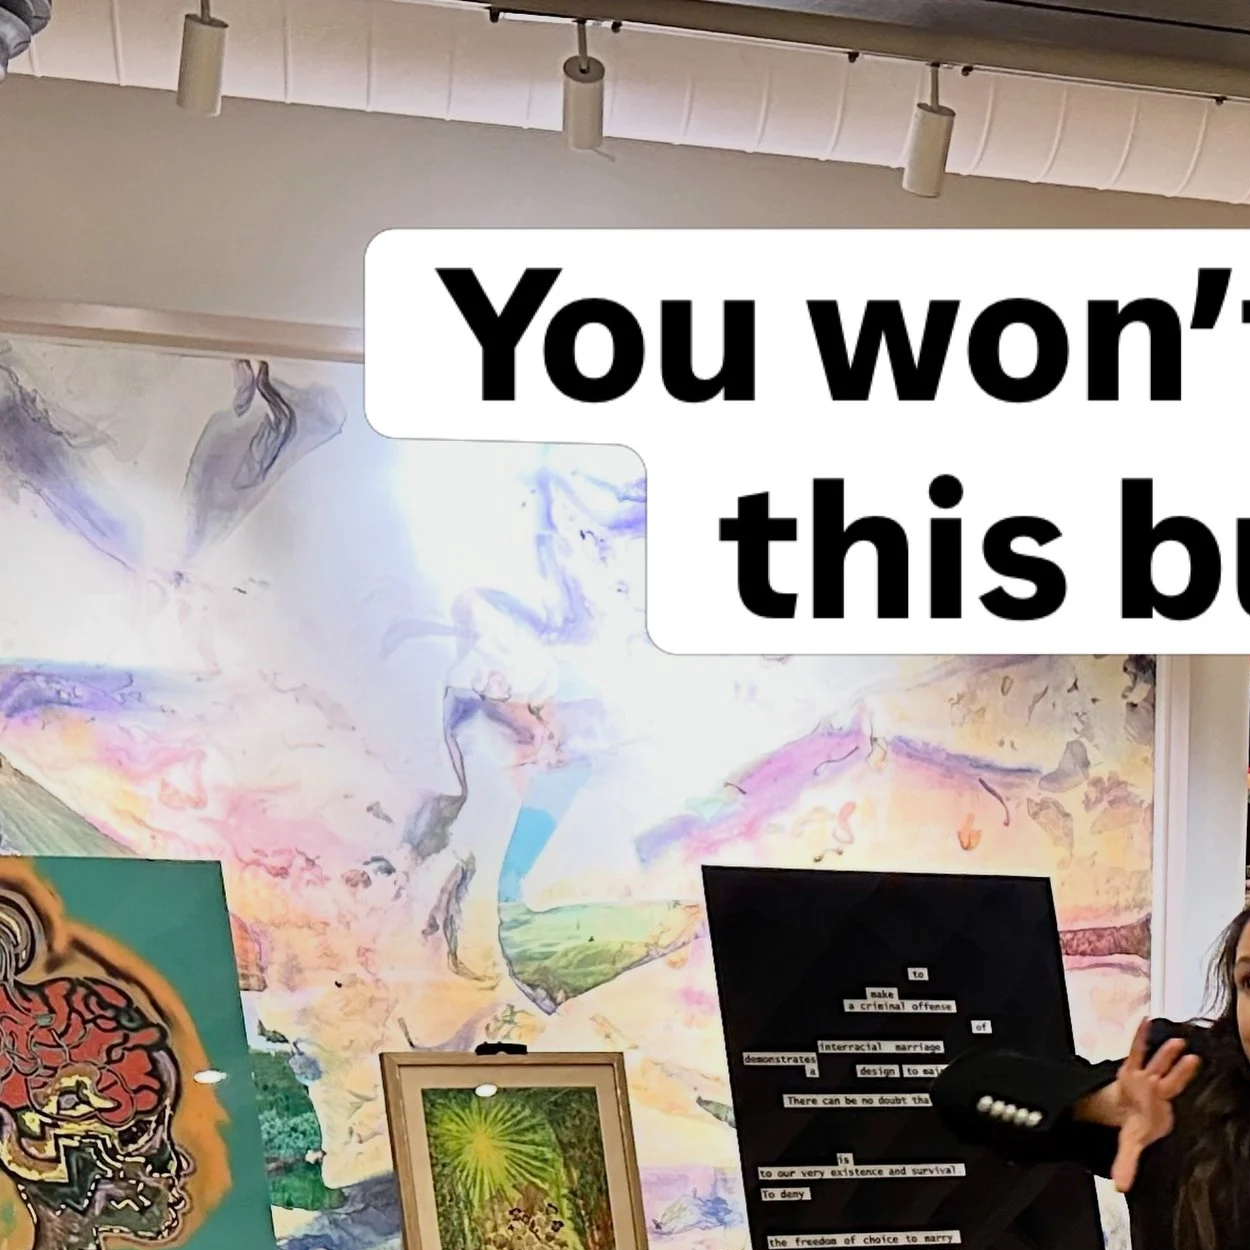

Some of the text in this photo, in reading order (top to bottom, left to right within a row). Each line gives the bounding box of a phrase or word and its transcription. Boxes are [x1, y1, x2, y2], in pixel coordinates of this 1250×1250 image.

[912, 970, 924, 979] to
[870, 990, 894, 999] make
[860, 1002, 905, 1011] criminal
[911, 1003, 952, 1011] offense
[976, 1023, 987, 1031] of
[819, 1042, 941, 1053] interracial marriage
[744, 1054, 816, 1064] demonstrates
[860, 1067, 895, 1077] design
[907, 1067, 919, 1075] to
[787, 1096, 817, 1105] There
[822, 1097, 840, 1105] can
[844, 1096, 858, 1105] be
[861, 1097, 874, 1105] no
[878, 1096, 907, 1105] doubt
[839, 1155, 849, 1164] is
[760, 1169, 772, 1178] to
[777, 1170, 795, 1178] our
[801, 1169, 825, 1179] very
[830, 1168, 883, 1177] existence
[888, 1166, 906, 1176] and
[762, 1189, 805, 1200] To deny
[769, 1235, 953, 1247] the freedom of choice to marry
